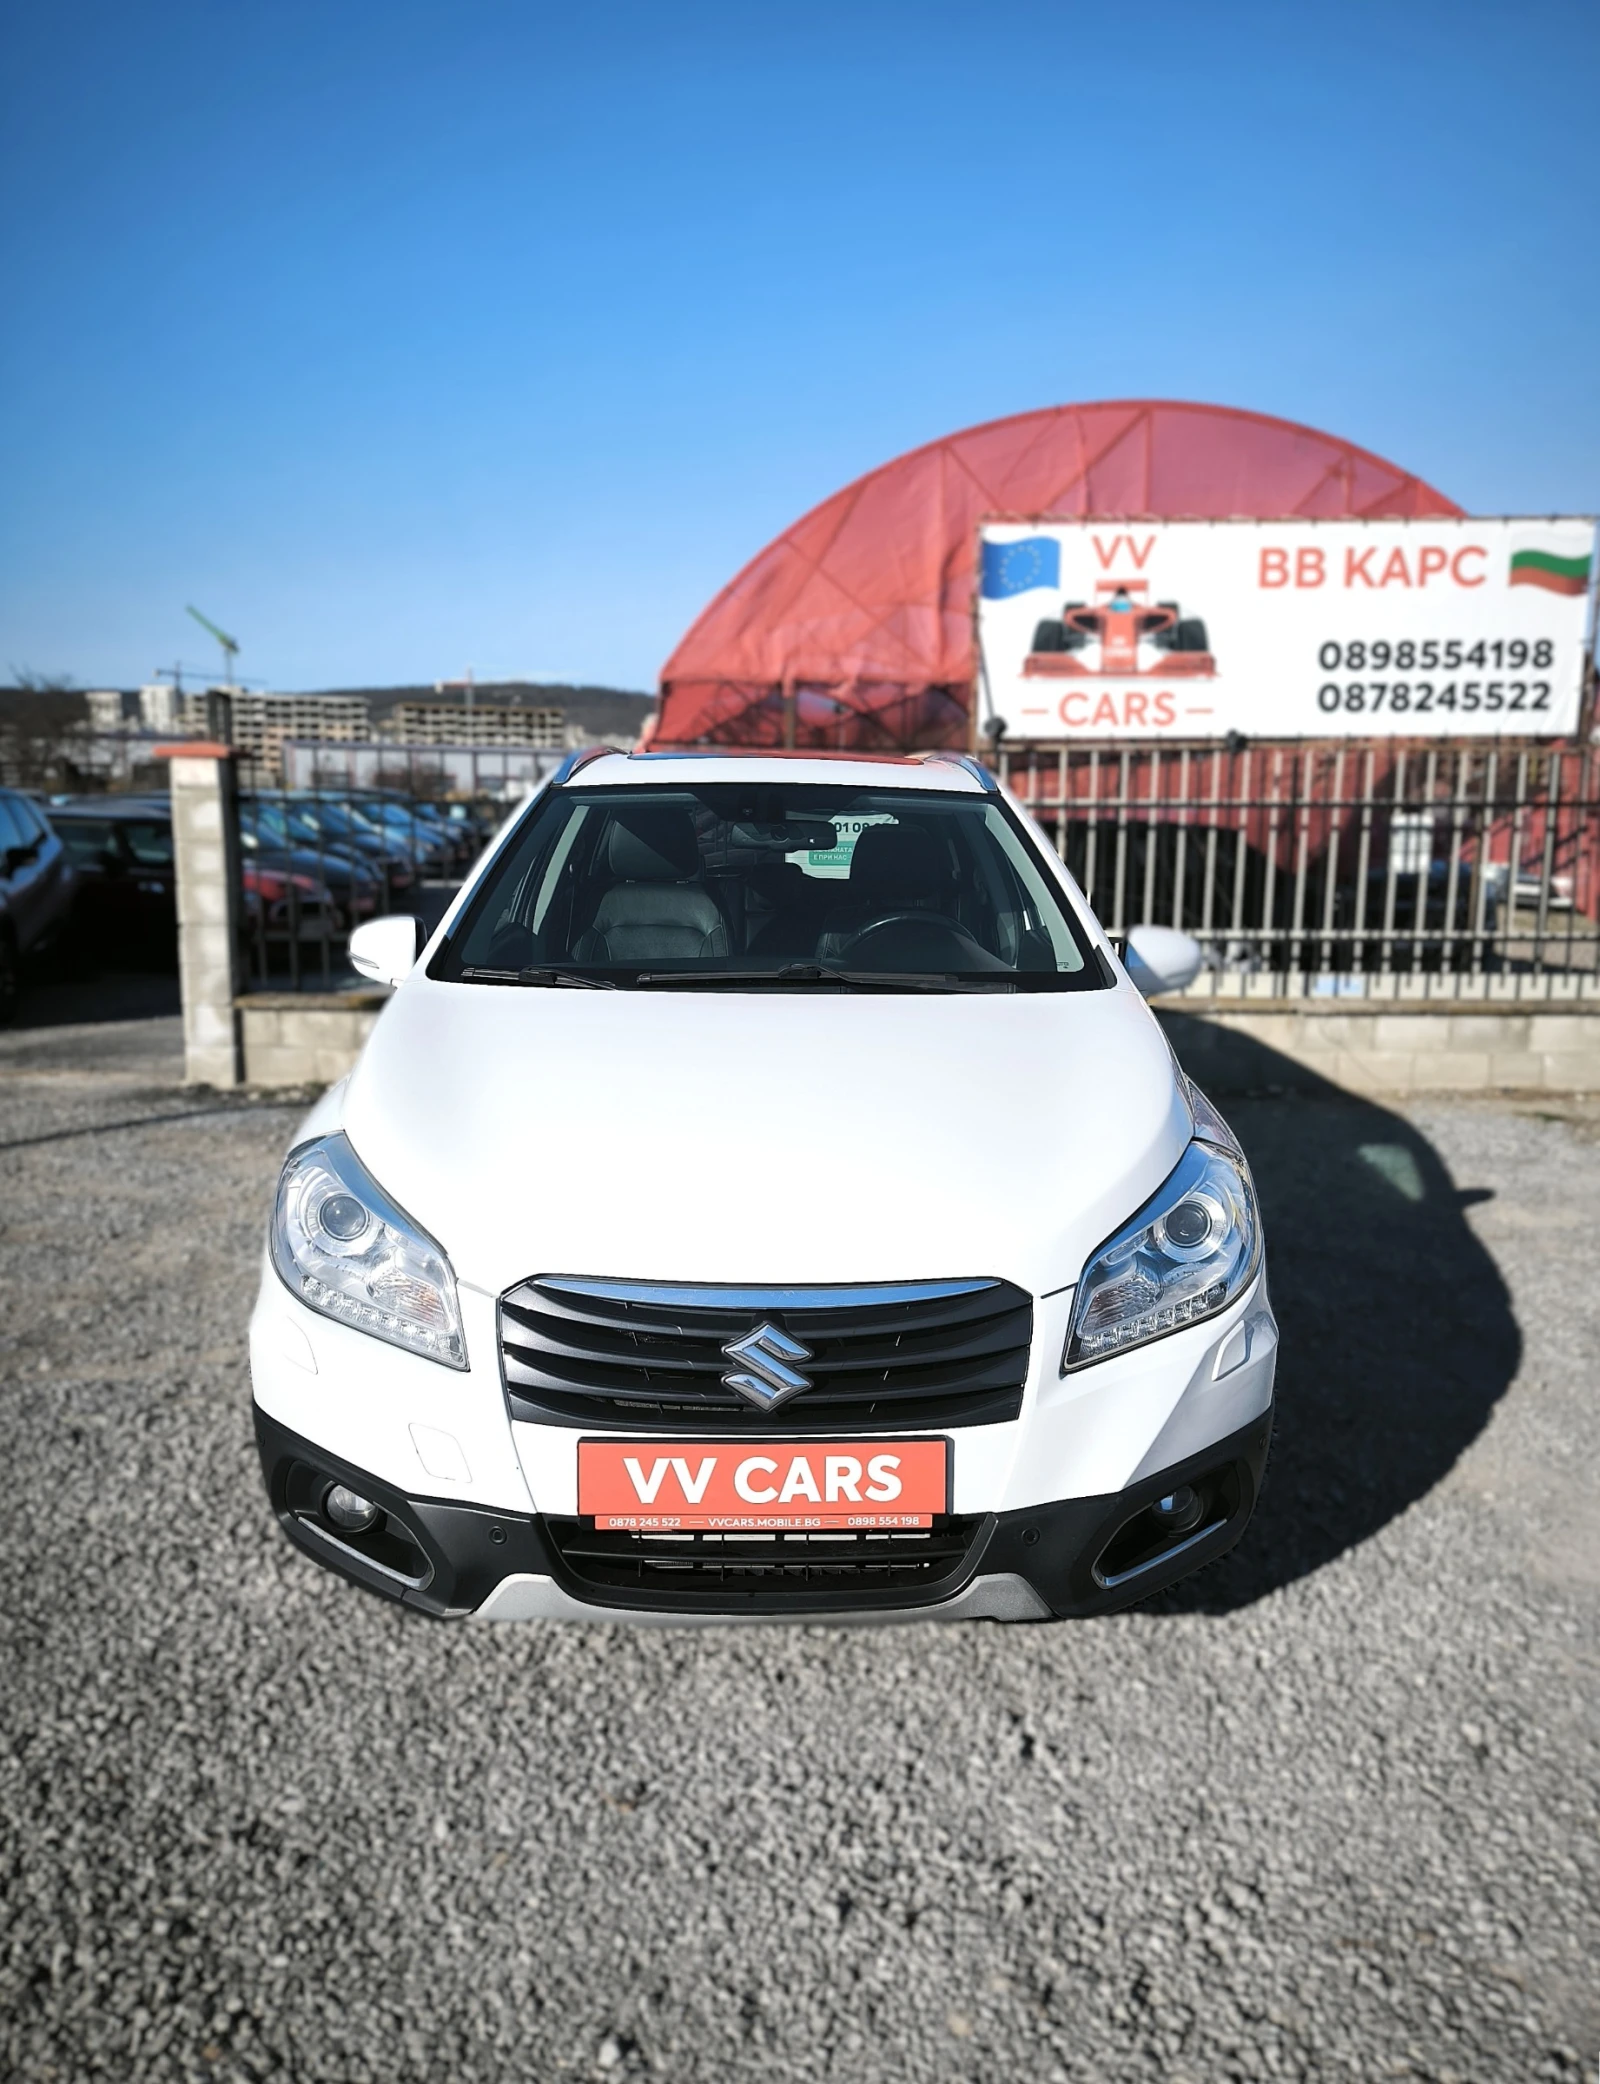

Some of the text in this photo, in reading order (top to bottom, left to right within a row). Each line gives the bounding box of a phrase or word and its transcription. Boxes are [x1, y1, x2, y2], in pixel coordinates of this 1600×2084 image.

[1091, 535, 1156, 569] VV
[1257, 545, 1488, 590] ВВ КАРС
[1319, 639, 1553, 671] 0898554198
[1058, 691, 1176, 727] CARS
[1318, 682, 1551, 712] 0878245522
[623, 1454, 903, 1504] VV CARS
[608, 1516, 920, 1528] 0878 245 522 VVCARS.MOBILE.BG 0898 554 198
